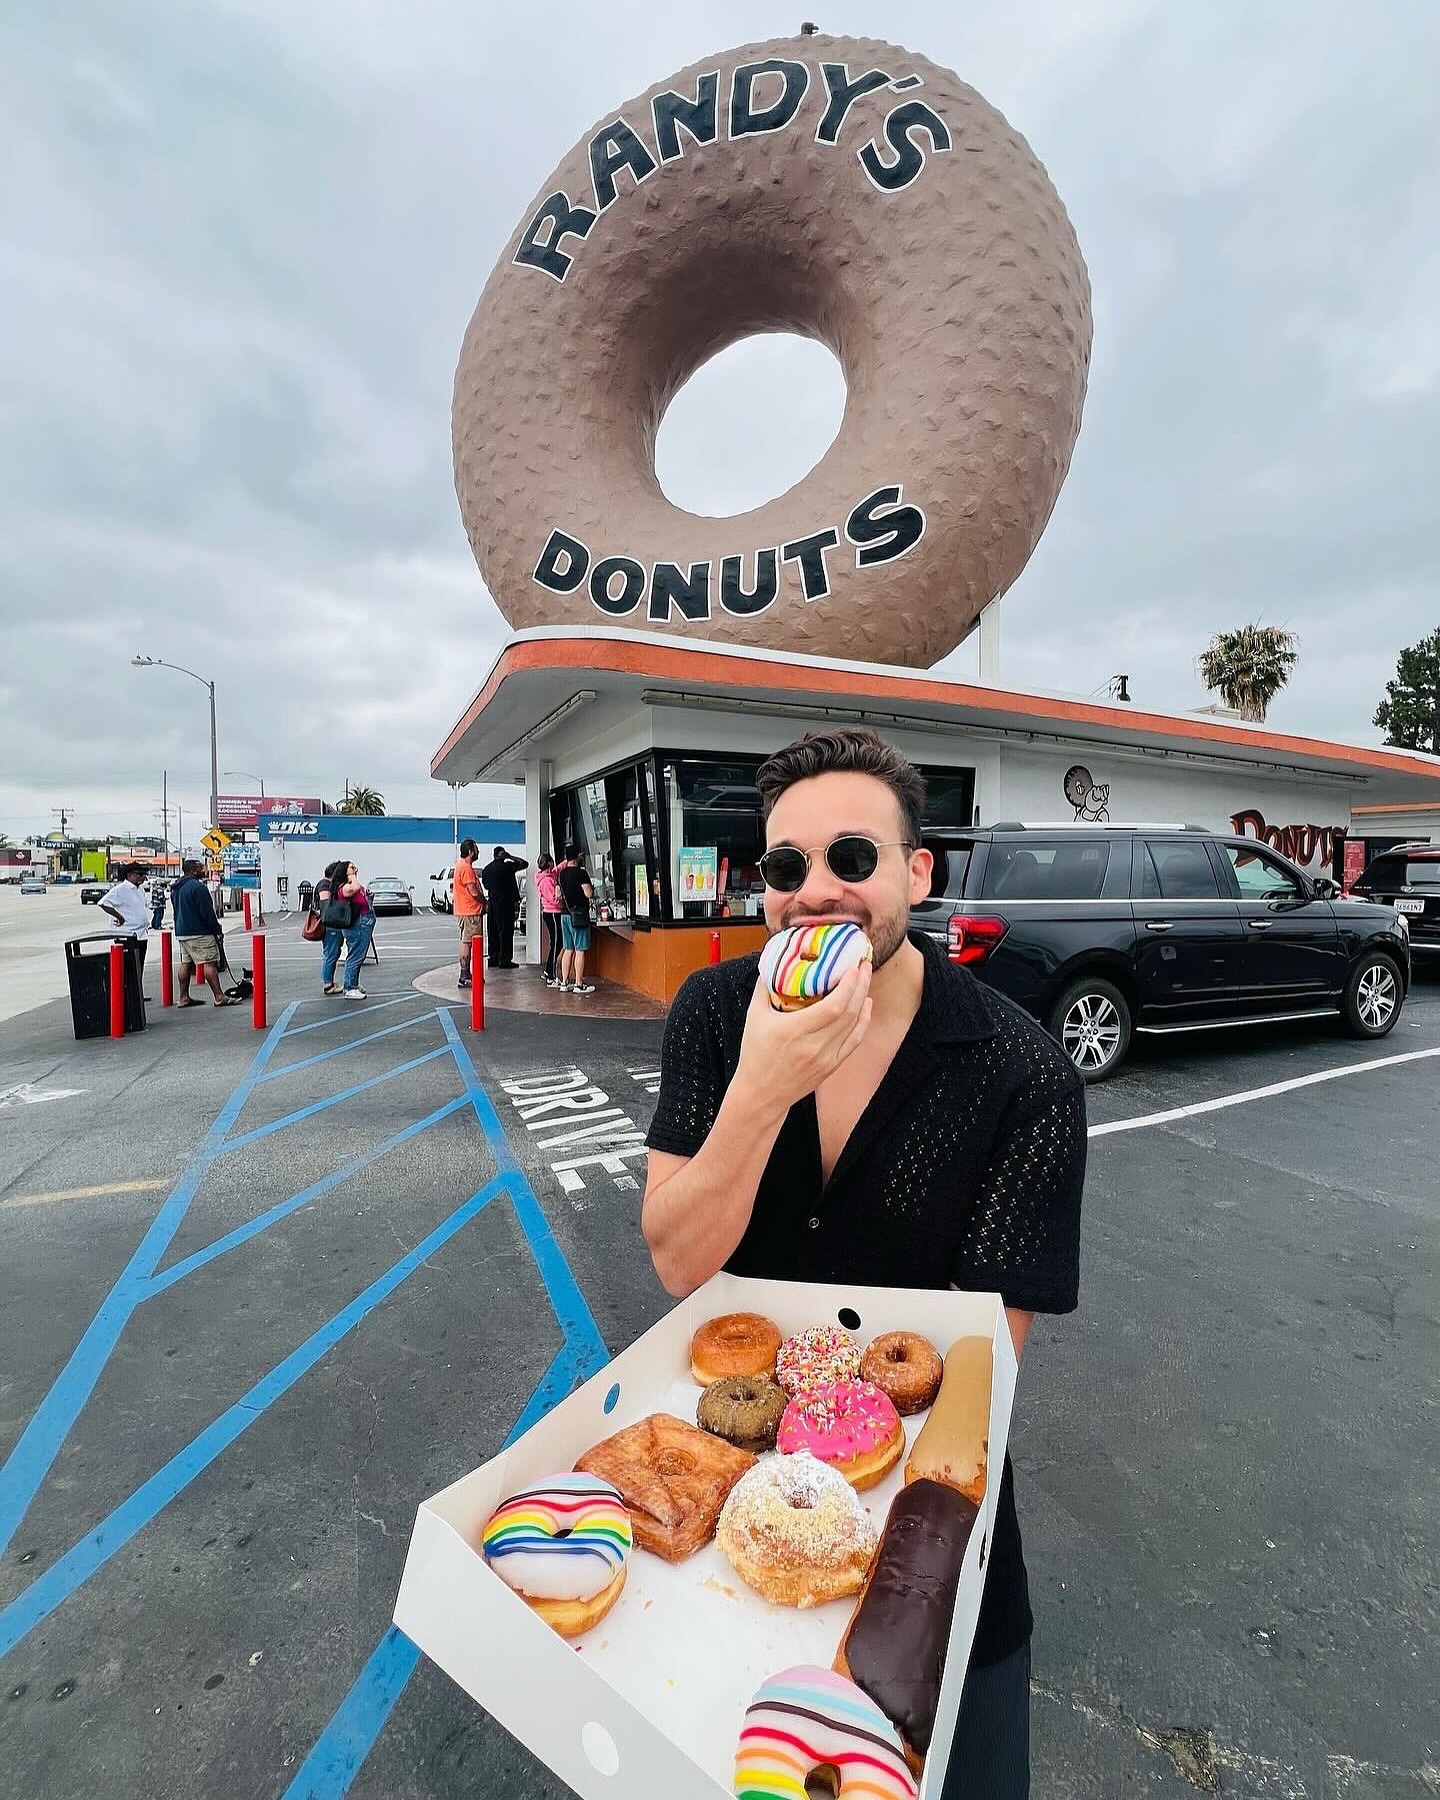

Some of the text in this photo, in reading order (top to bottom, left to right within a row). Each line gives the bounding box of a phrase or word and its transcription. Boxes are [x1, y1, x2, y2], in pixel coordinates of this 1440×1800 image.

[512, 58, 953, 283] RANDY'S
[531, 484, 927, 624] DONUTS
[40, 841, 60, 849] Days
